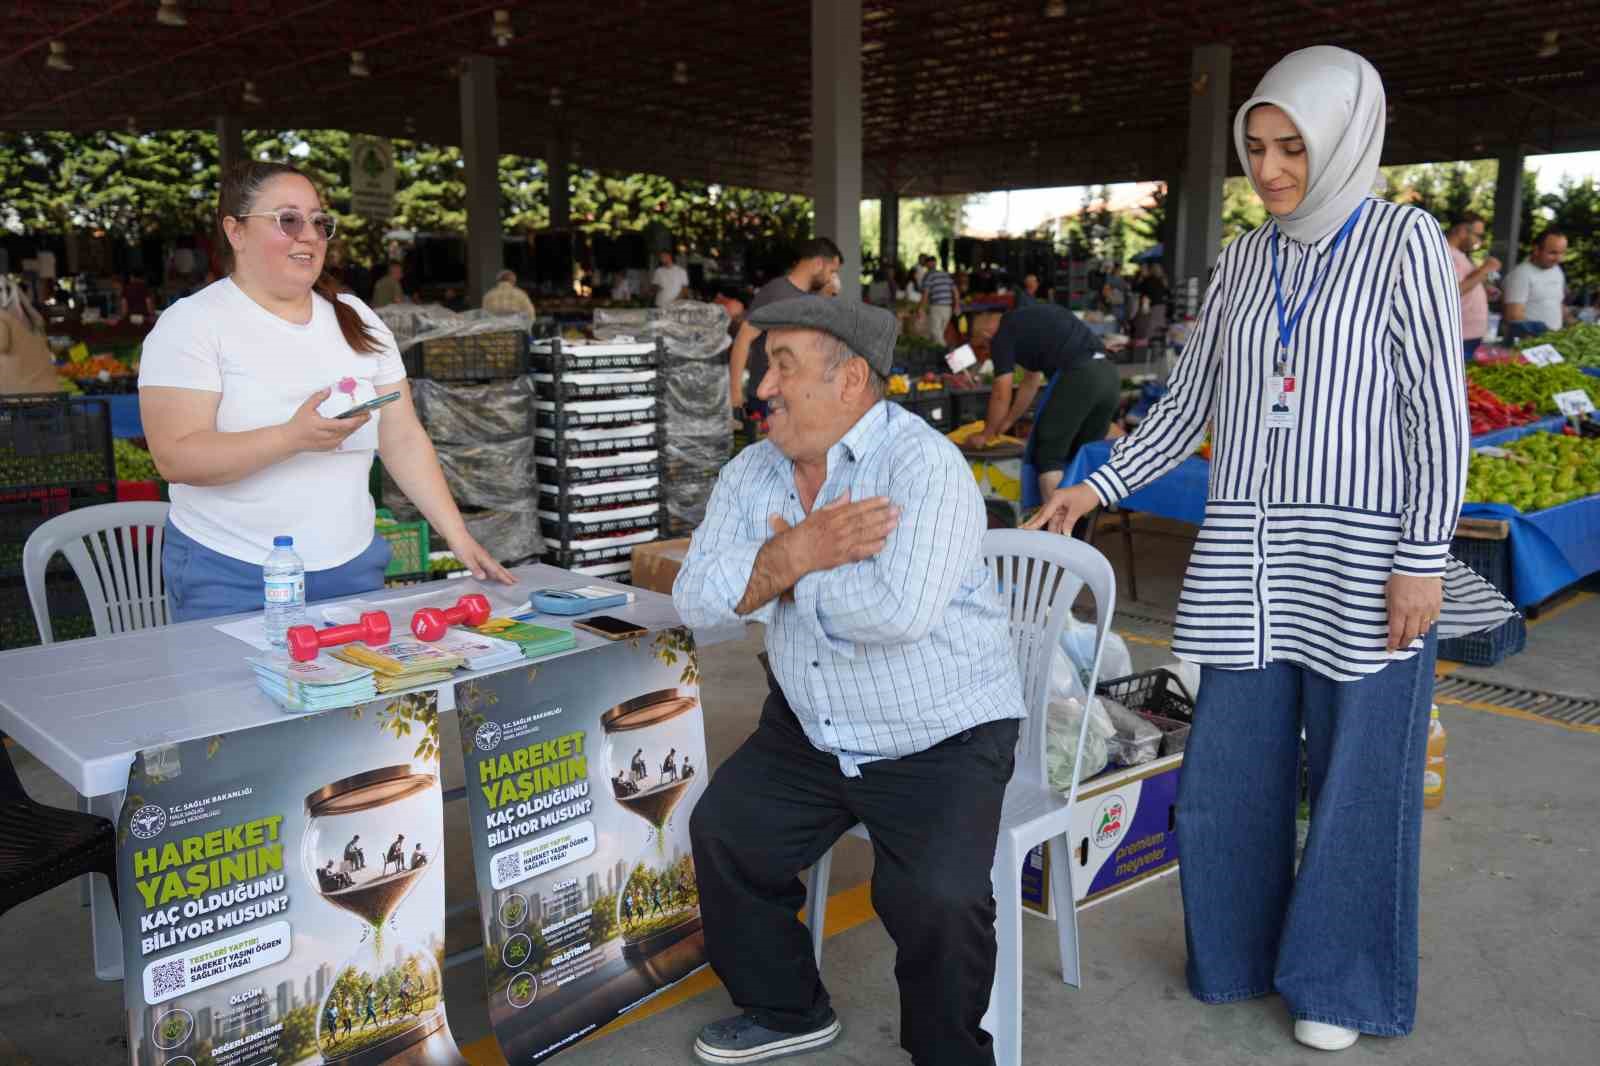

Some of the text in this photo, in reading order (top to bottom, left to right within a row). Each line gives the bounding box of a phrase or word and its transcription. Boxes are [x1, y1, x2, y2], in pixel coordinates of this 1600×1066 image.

[479, 731, 586, 783] HAREKET
[169, 787, 253, 814] T.C. SAĞLIK BAKANLIĞI
[482, 755, 587, 809] YAŞININ
[486, 782, 589, 829] KAÇ OLDUĞUNU
[133, 815, 283, 878] HAREKET
[487, 800, 592, 848] BİLİYOR MUSUN?
[1115, 832, 1165, 862] premium
[136, 844, 285, 909] YAŞININ
[523, 851, 549, 865] HAREKET
[524, 858, 549, 872] SAĞLIKLI
[140, 874, 285, 933] KAÇ OLDUĞUNU
[141, 895, 289, 955] BİLİYOR MUSUN?
[190, 938, 282, 975] HAREKET YAŞINI ÖĞREN
[191, 957, 251, 983] SAĞLIKLI YAŞA!
